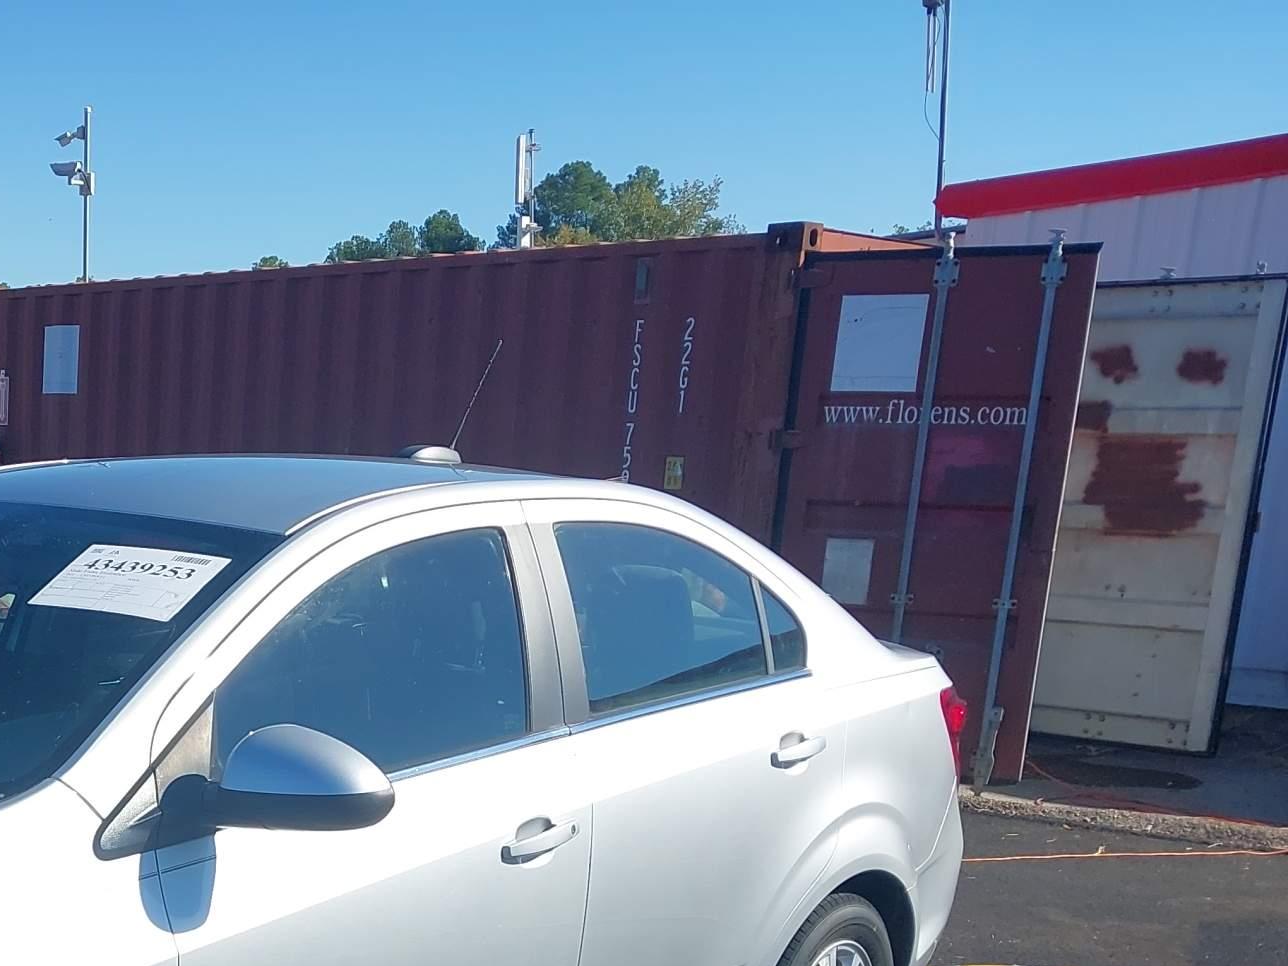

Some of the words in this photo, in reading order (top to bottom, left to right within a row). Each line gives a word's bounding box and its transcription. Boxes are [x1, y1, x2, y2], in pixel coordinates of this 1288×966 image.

[628, 319, 645, 413] FSCU
[679, 317, 695, 413] 22G1
[83, 558, 196, 580] 43439253
